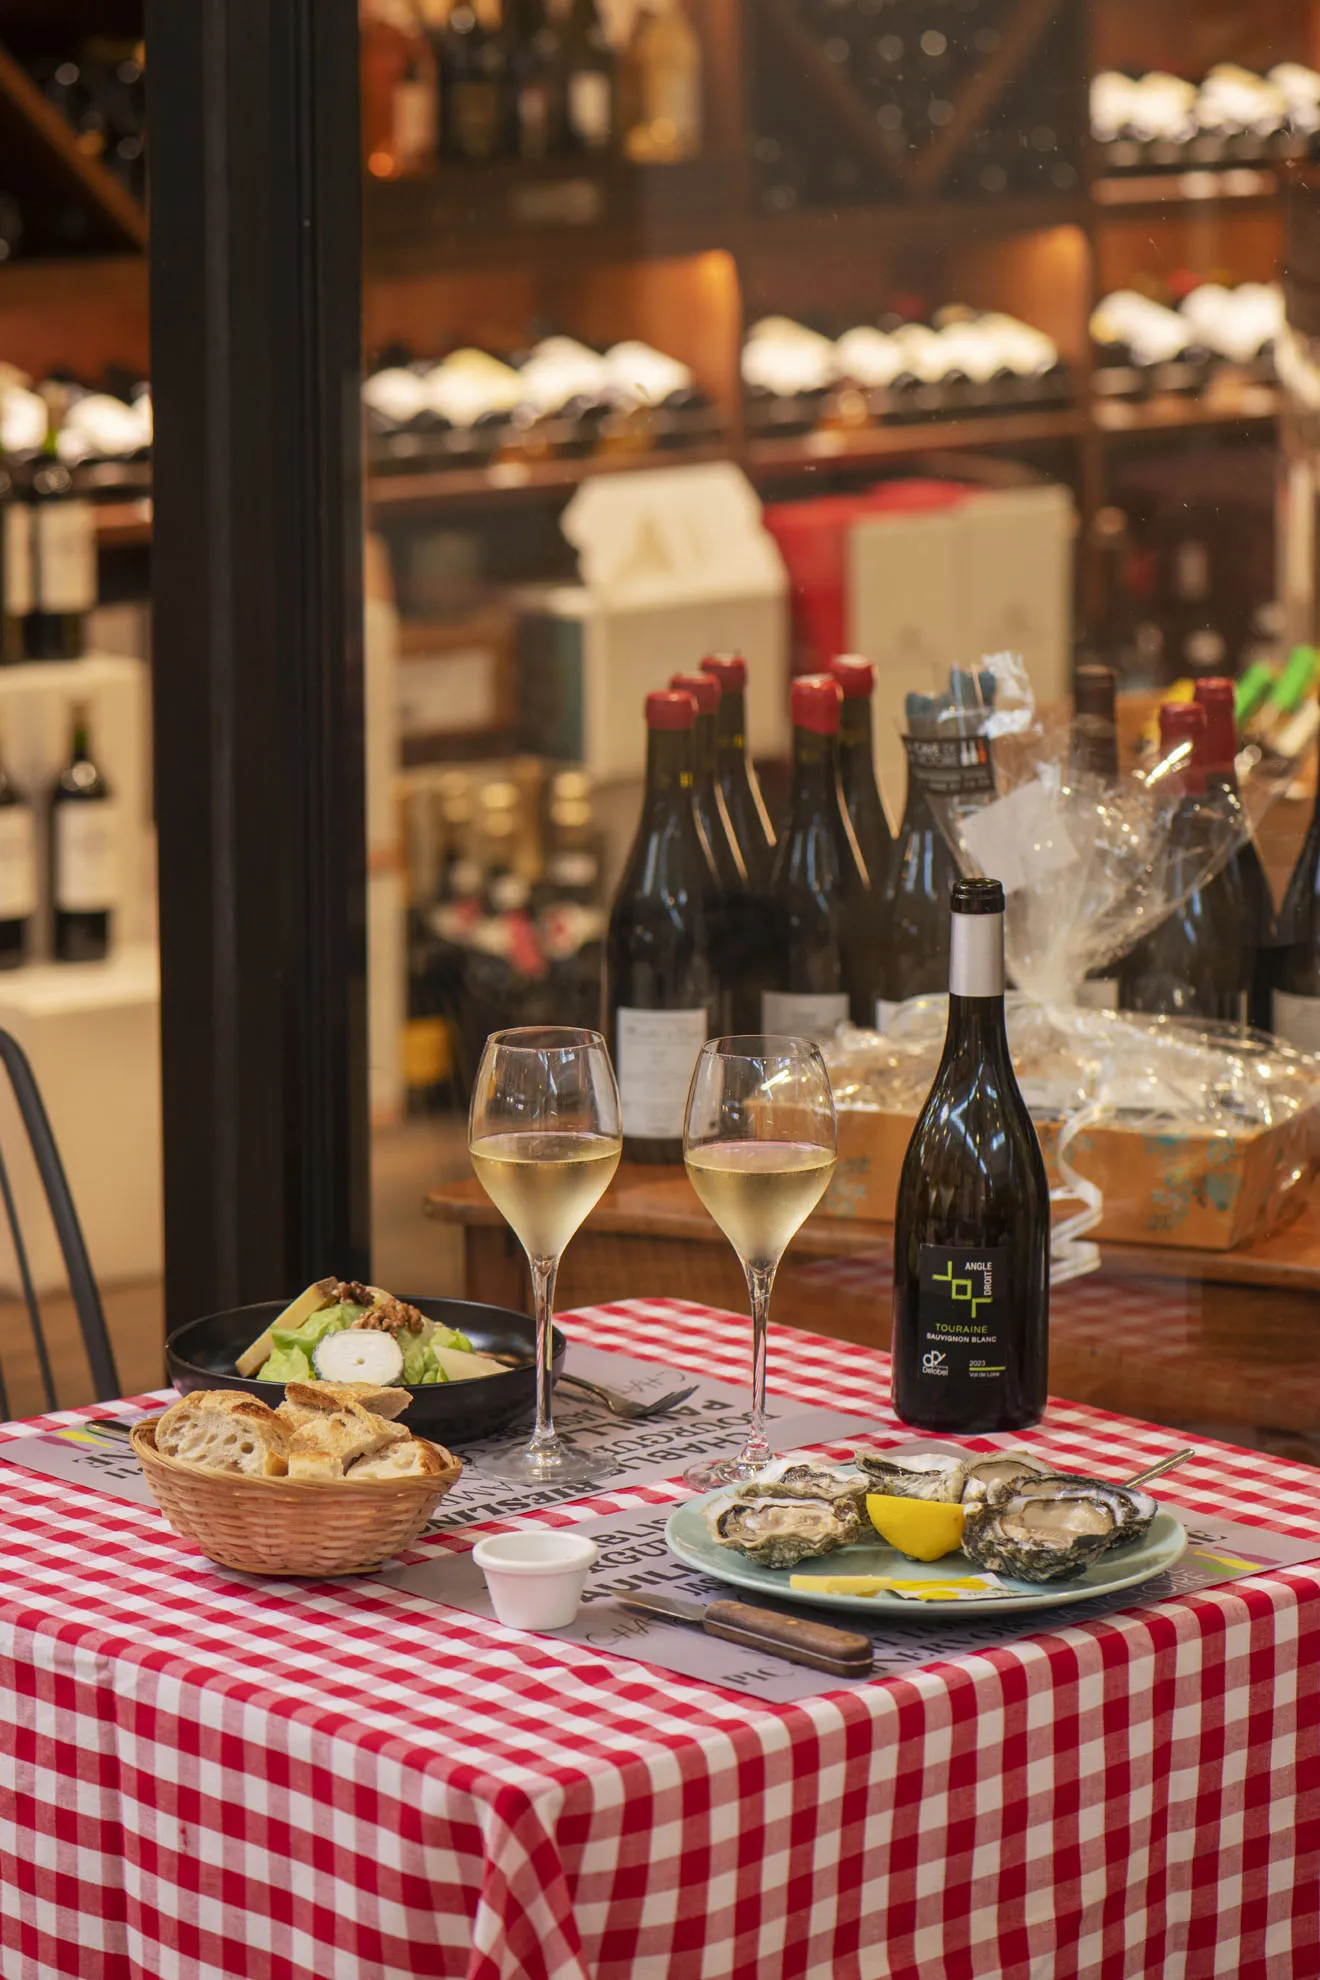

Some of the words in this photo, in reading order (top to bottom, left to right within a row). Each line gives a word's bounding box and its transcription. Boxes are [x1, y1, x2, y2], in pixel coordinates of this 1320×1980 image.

[965, 1261, 992, 1271] ANGLE
[984, 1272, 992, 1295] DROIT
[935, 1322, 988, 1334] TOURAINE
[926, 1332, 970, 1343] SAUVIGNON
[971, 1335, 997, 1343] BLANC
[969, 1359, 986, 1367] 2023
[1088, 1569, 1218, 1608] VICTOIRE
